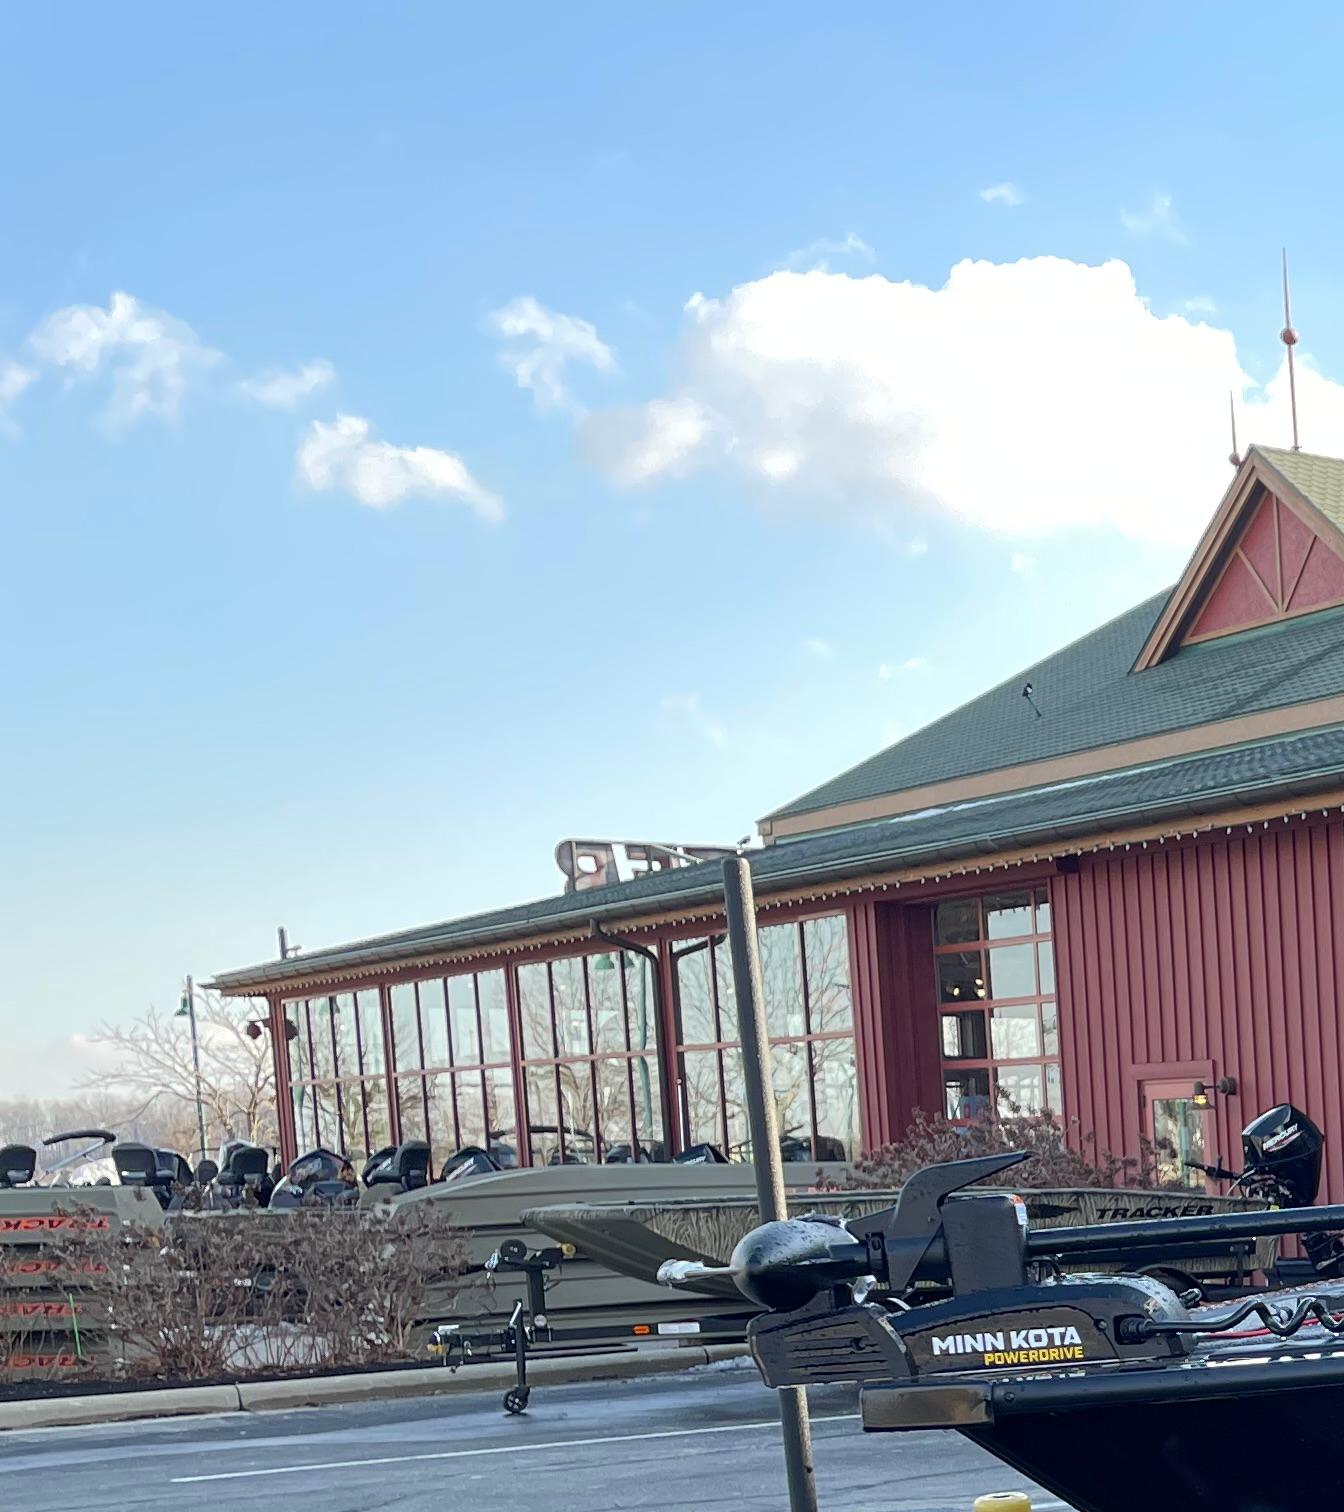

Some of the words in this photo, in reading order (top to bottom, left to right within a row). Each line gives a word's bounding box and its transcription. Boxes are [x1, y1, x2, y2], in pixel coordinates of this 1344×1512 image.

[1096, 1204, 1214, 1220] TRACKER
[932, 1332, 1005, 1356] MINN
[1009, 1326, 1082, 1350] KOTA
[983, 1346, 1085, 1366] POWERDRIVE
